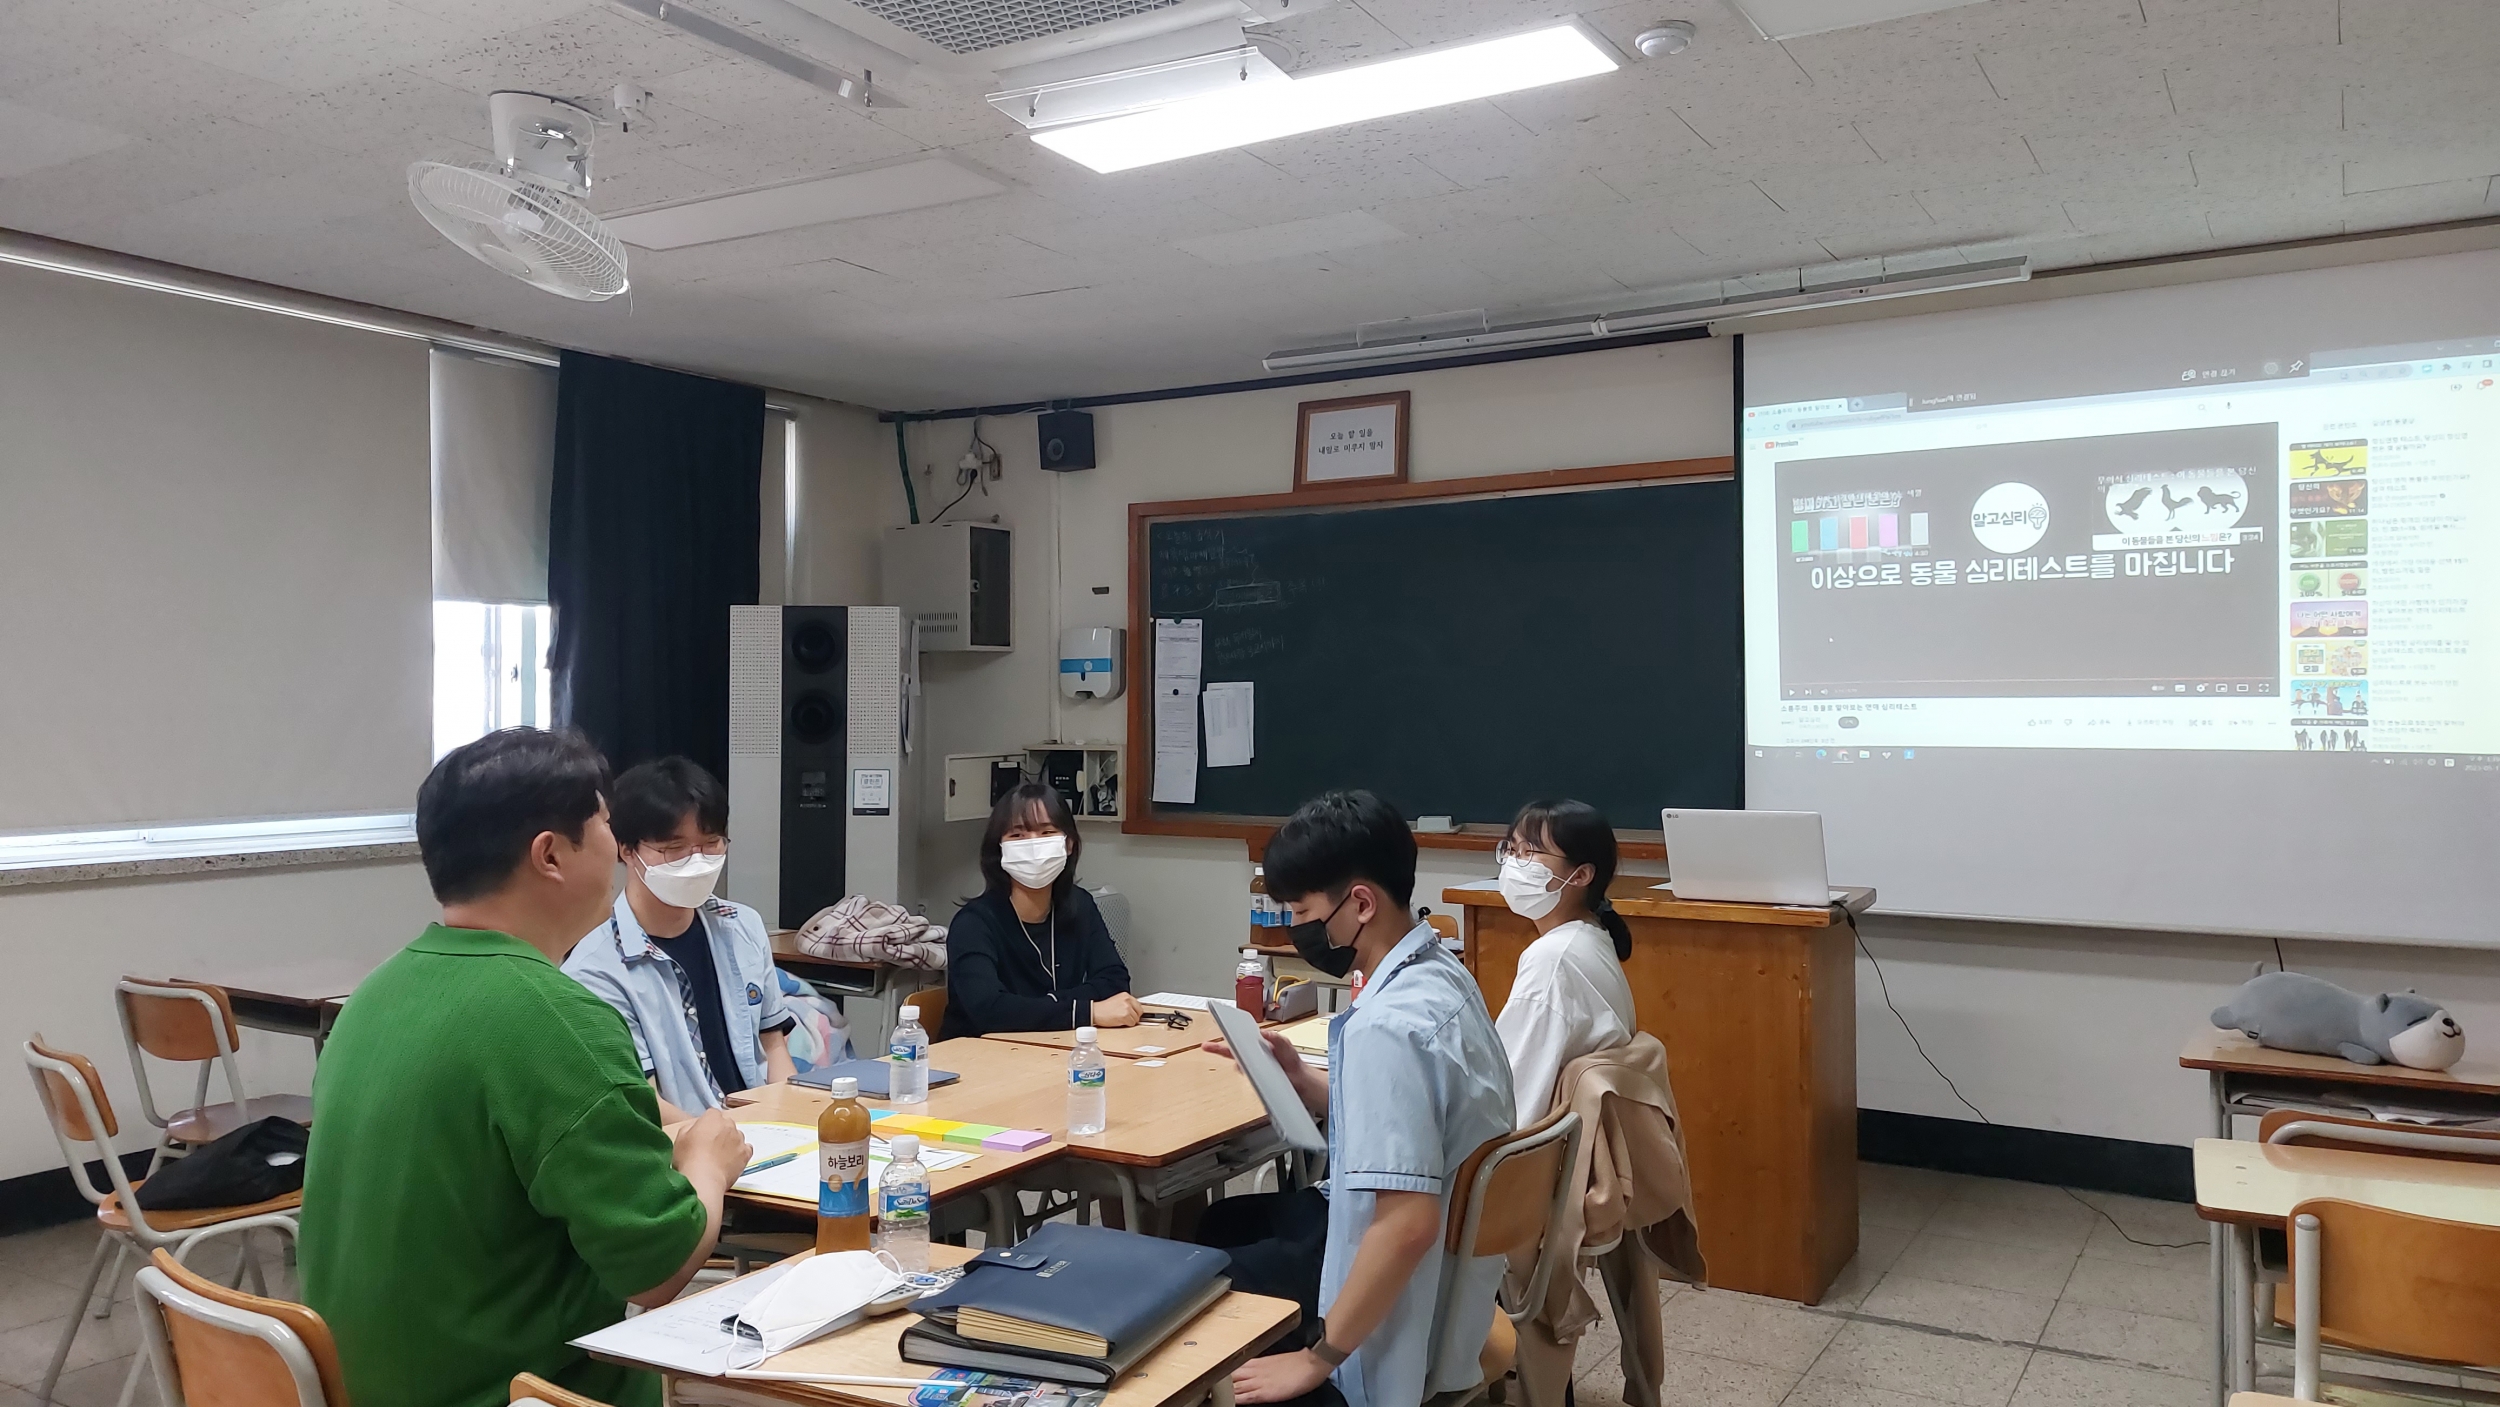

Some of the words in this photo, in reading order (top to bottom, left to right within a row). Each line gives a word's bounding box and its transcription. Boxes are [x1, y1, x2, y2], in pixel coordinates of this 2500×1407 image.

[1330, 432, 1343, 440] 오늘
[1348, 430, 1355, 439] 할
[1359, 428, 1373, 438] 일을
[1318, 445, 1340, 455] 내일로
[1343, 441, 1365, 453] 미루지
[1775, 440, 1799, 448] Premium
[2238, 466, 2258, 476] 당신
[2298, 483, 2320, 491] 당신의
[1973, 511, 2027, 528] 알고심리
[2122, 537, 2130, 546] 이
[2132, 536, 2163, 546] 동물들을
[2166, 535, 2174, 544] 본
[2175, 534, 2200, 544] 당신의
[1811, 563, 1903, 590] 이상으로
[1910, 560, 1958, 586] 동물
[1965, 553, 2116, 585] 심리테스트를
[2124, 548, 2236, 577] 마칩니다
[1835, 703, 1863, 712] 알아보는
[1881, 703, 1918, 711] 심리테스트
[828, 1154, 864, 1170] 하늘보리
